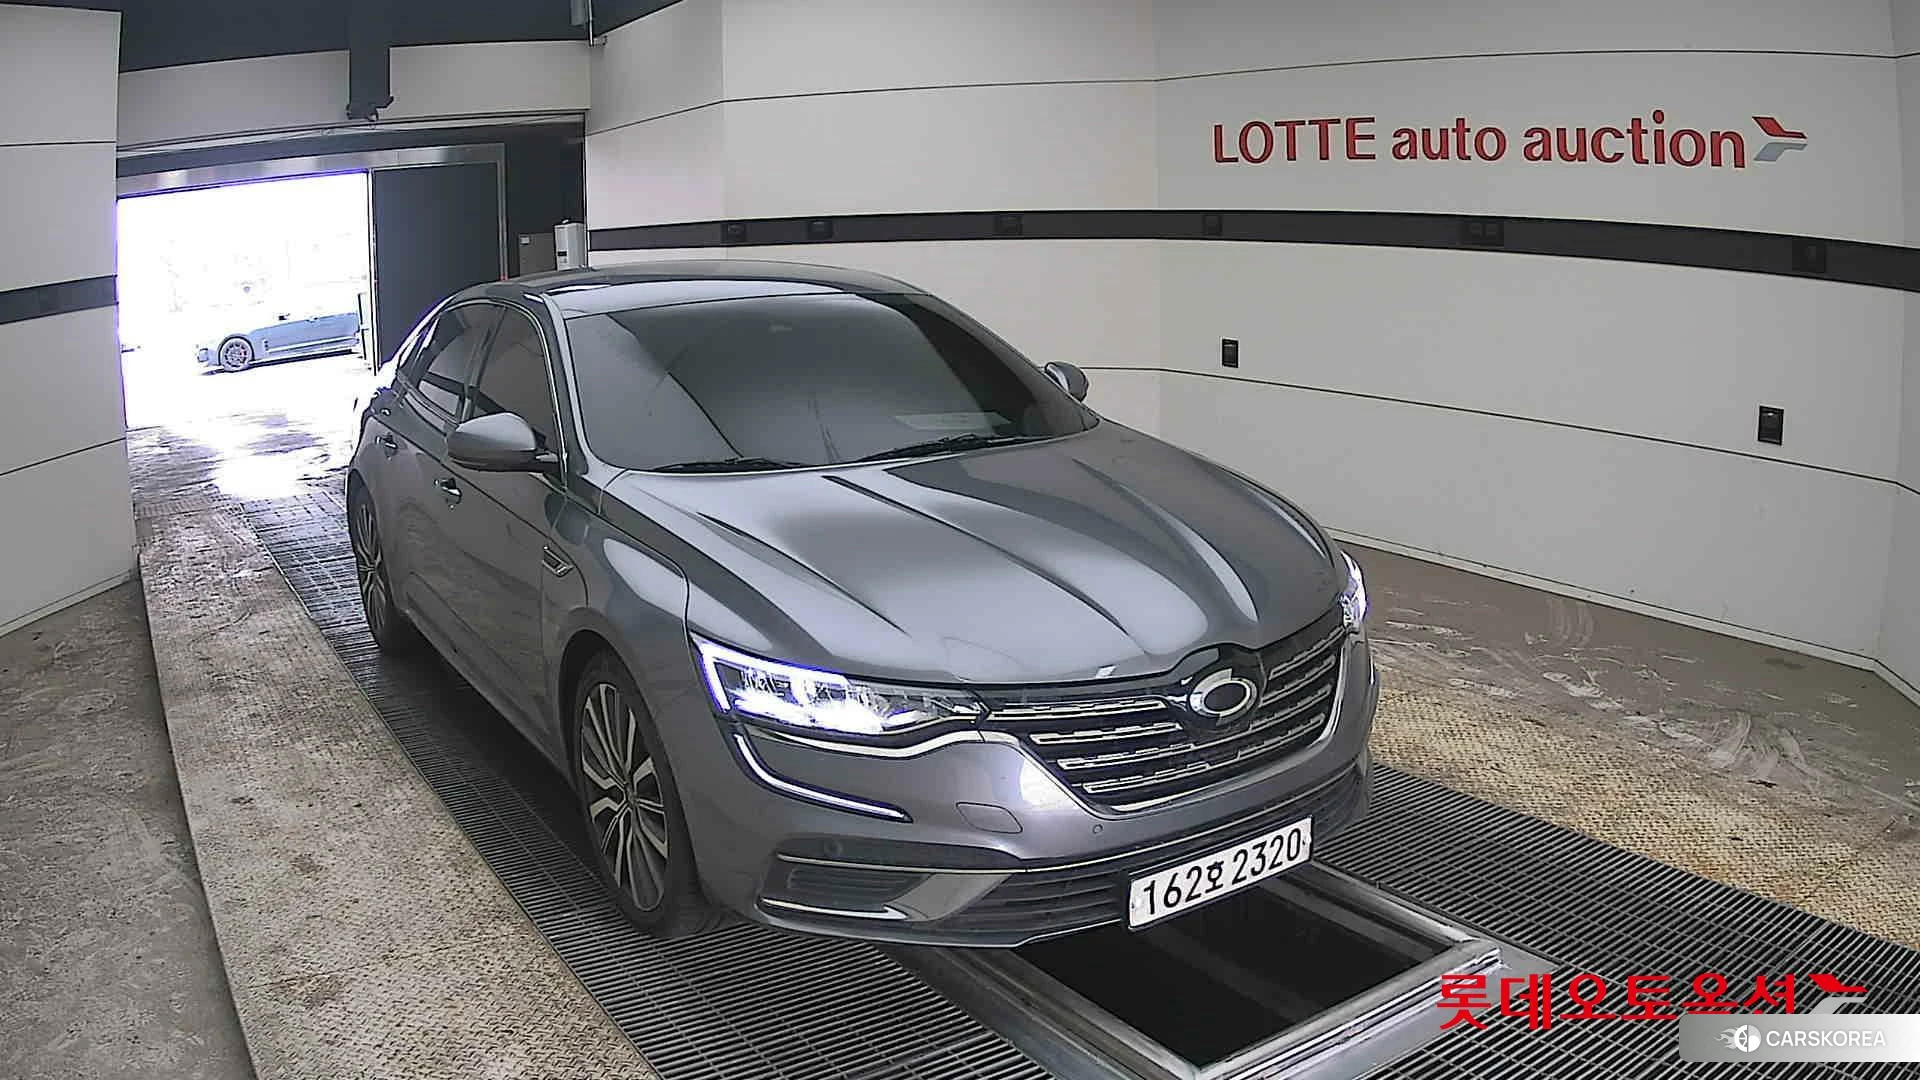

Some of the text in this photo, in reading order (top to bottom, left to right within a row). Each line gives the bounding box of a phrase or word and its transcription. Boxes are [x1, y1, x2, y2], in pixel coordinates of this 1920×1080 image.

[1213, 110, 1746, 169] LOTTE auto auction
[1232, 828, 1301, 886] 2320
